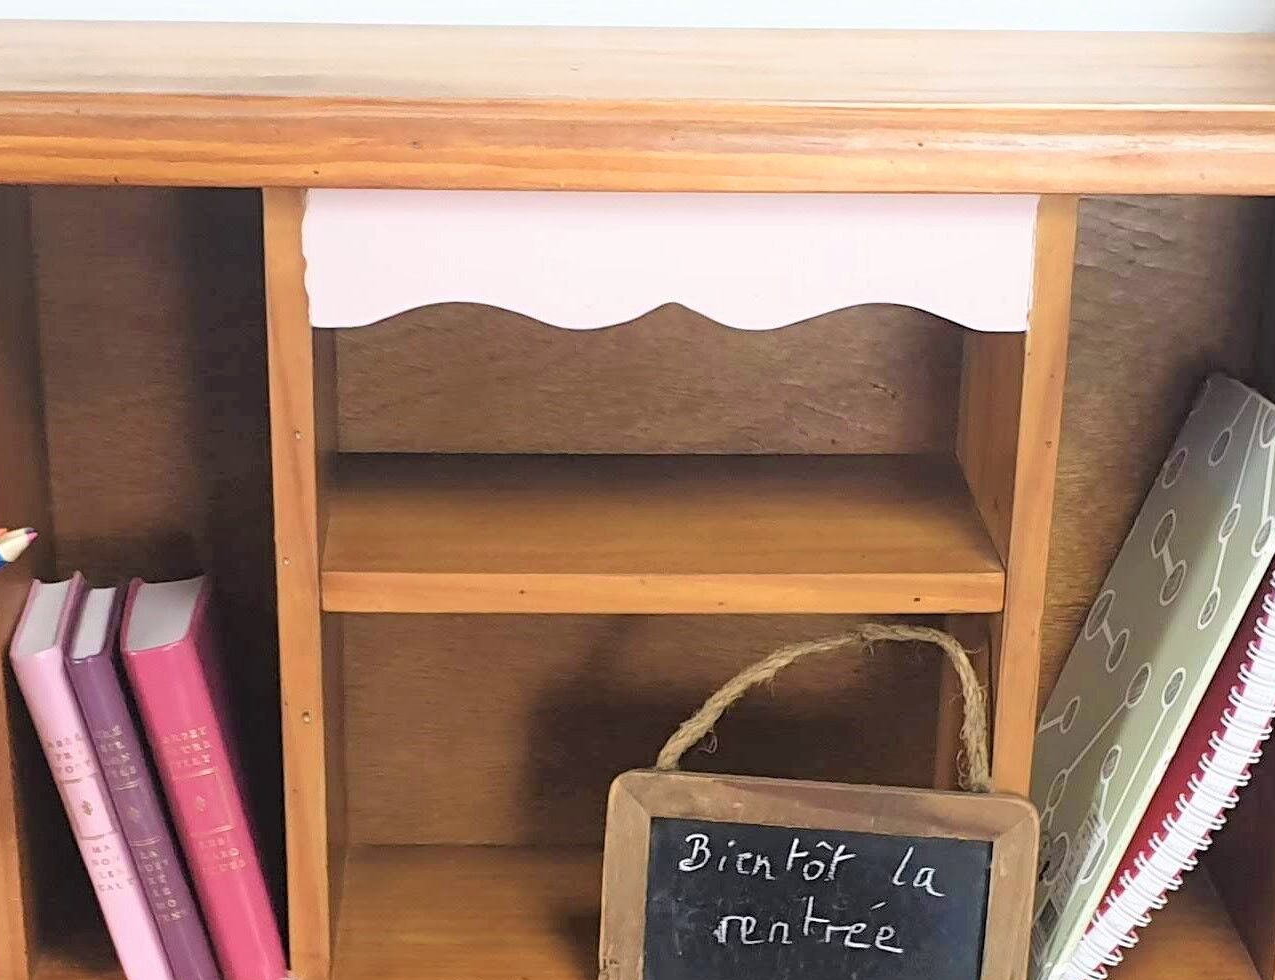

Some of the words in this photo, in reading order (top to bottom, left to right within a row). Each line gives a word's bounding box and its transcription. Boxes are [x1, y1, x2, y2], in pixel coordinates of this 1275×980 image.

[678, 833, 856, 881] Bientôt
[892, 846, 946, 896] la
[713, 897, 904, 953] rentrée
